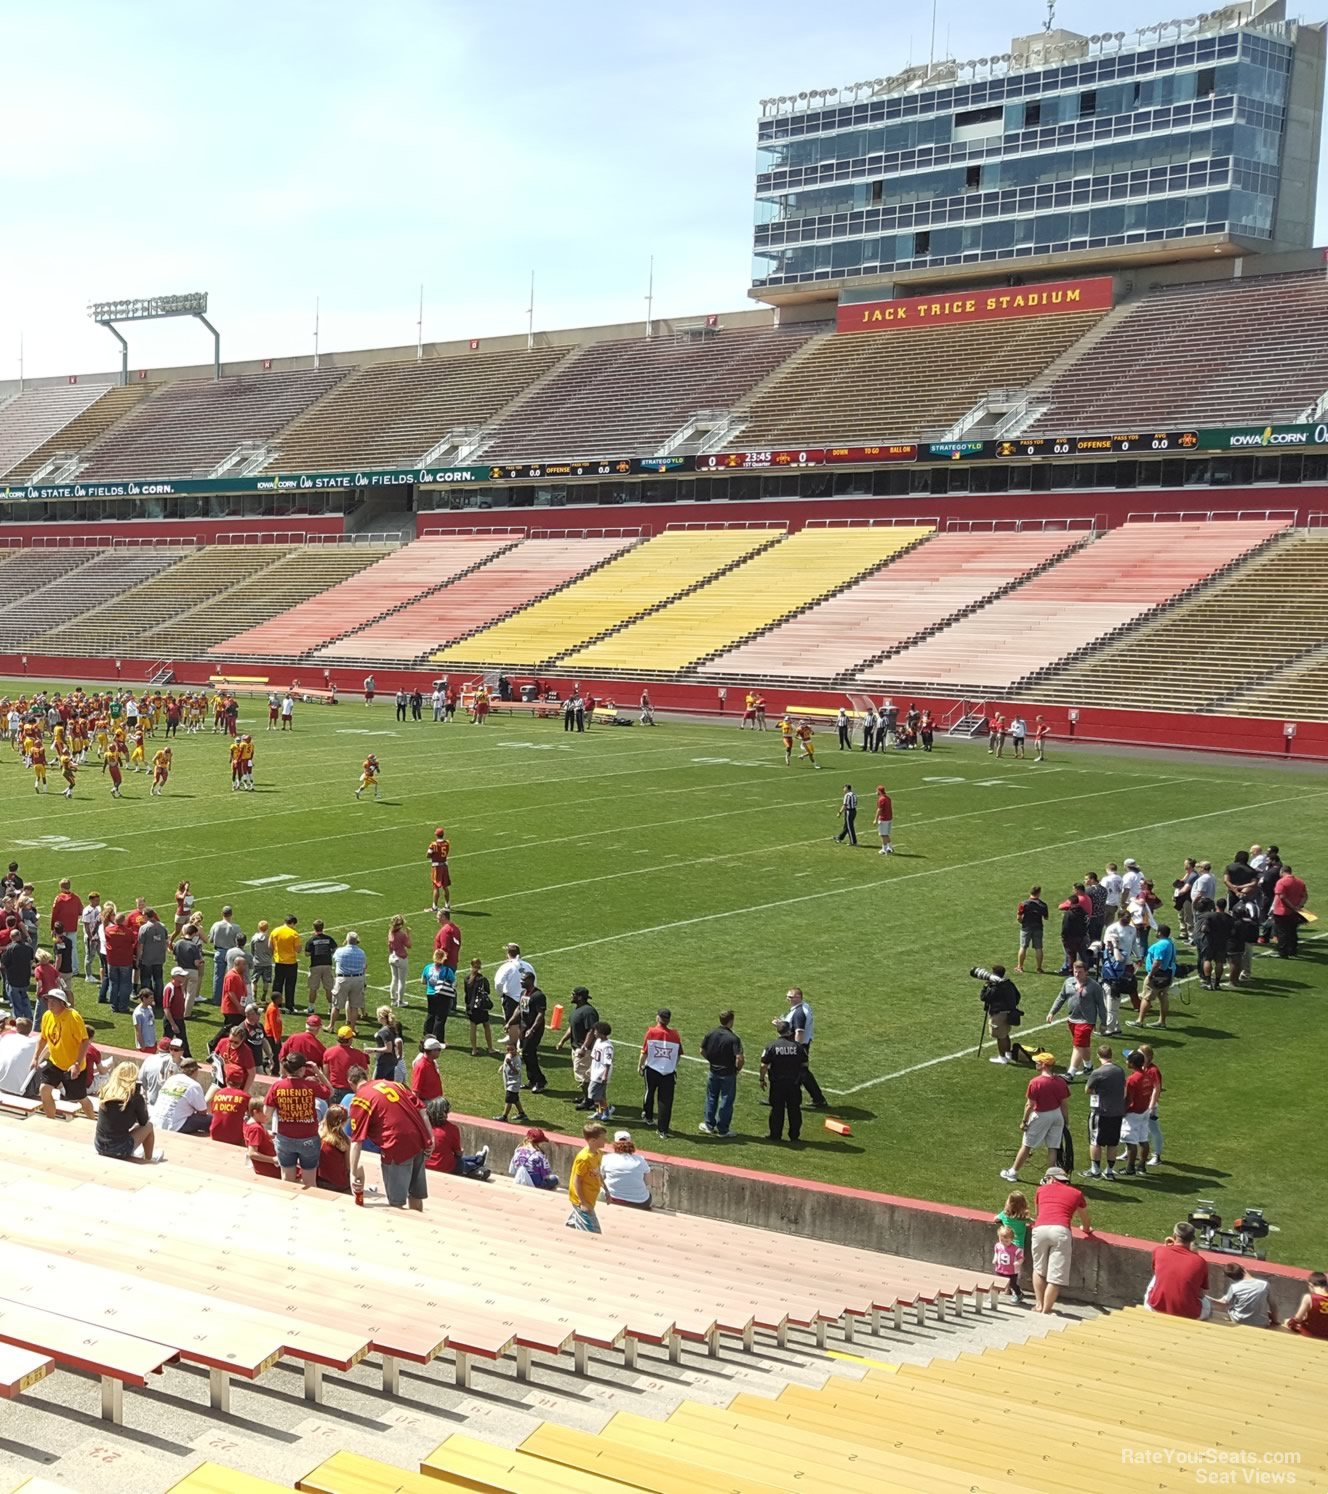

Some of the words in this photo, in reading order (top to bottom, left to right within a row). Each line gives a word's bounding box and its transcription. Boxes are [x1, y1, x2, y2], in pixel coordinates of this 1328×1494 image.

[862, 306, 907, 322] JACK
[918, 300, 976, 317] TRICE
[986, 288, 1081, 310] STADIUM
[1121, 441, 1129, 450] 0
[1152, 439, 1168, 449] 0.0
[1230, 435, 1262, 446] IOWA
[1270, 433, 1307, 443] CORN
[931, 443, 966, 451] STRATEGO
[1027, 446, 1034, 455] 0
[1054, 444, 1069, 454] 0.0
[1077, 441, 1112, 449] OFFENSE
[708, 457, 716, 466] 0
[745, 452, 772, 462] 23:45
[798, 452, 807, 462] 0
[510, 470, 516, 478] 0
[529, 469, 541, 477] 0.0
[546, 466, 571, 474] OFFENSE
[577, 467, 583, 475] 0
[598, 466, 610, 474] 0.0
[315, 477, 354, 488] STATE.
[371, 475, 417, 486] FIELDS.
[436, 471, 475, 482] CORN.
[8, 491, 25, 499] CORN
[41, 488, 74, 498] STATE.
[88, 487, 127, 497] FIELDS.
[142, 485, 175, 494] CORN.
[9, 835, 109, 852] 20
[235, 873, 351, 894] 10
[775, 1046, 798, 1056] POLICE
[276, 1088, 313, 1097] FRIENDS
[373, 1081, 400, 1103] 5
[234, 1095, 244, 1104] BE
[213, 1103, 219, 1111] A
[219, 1103, 238, 1113] DICK.
